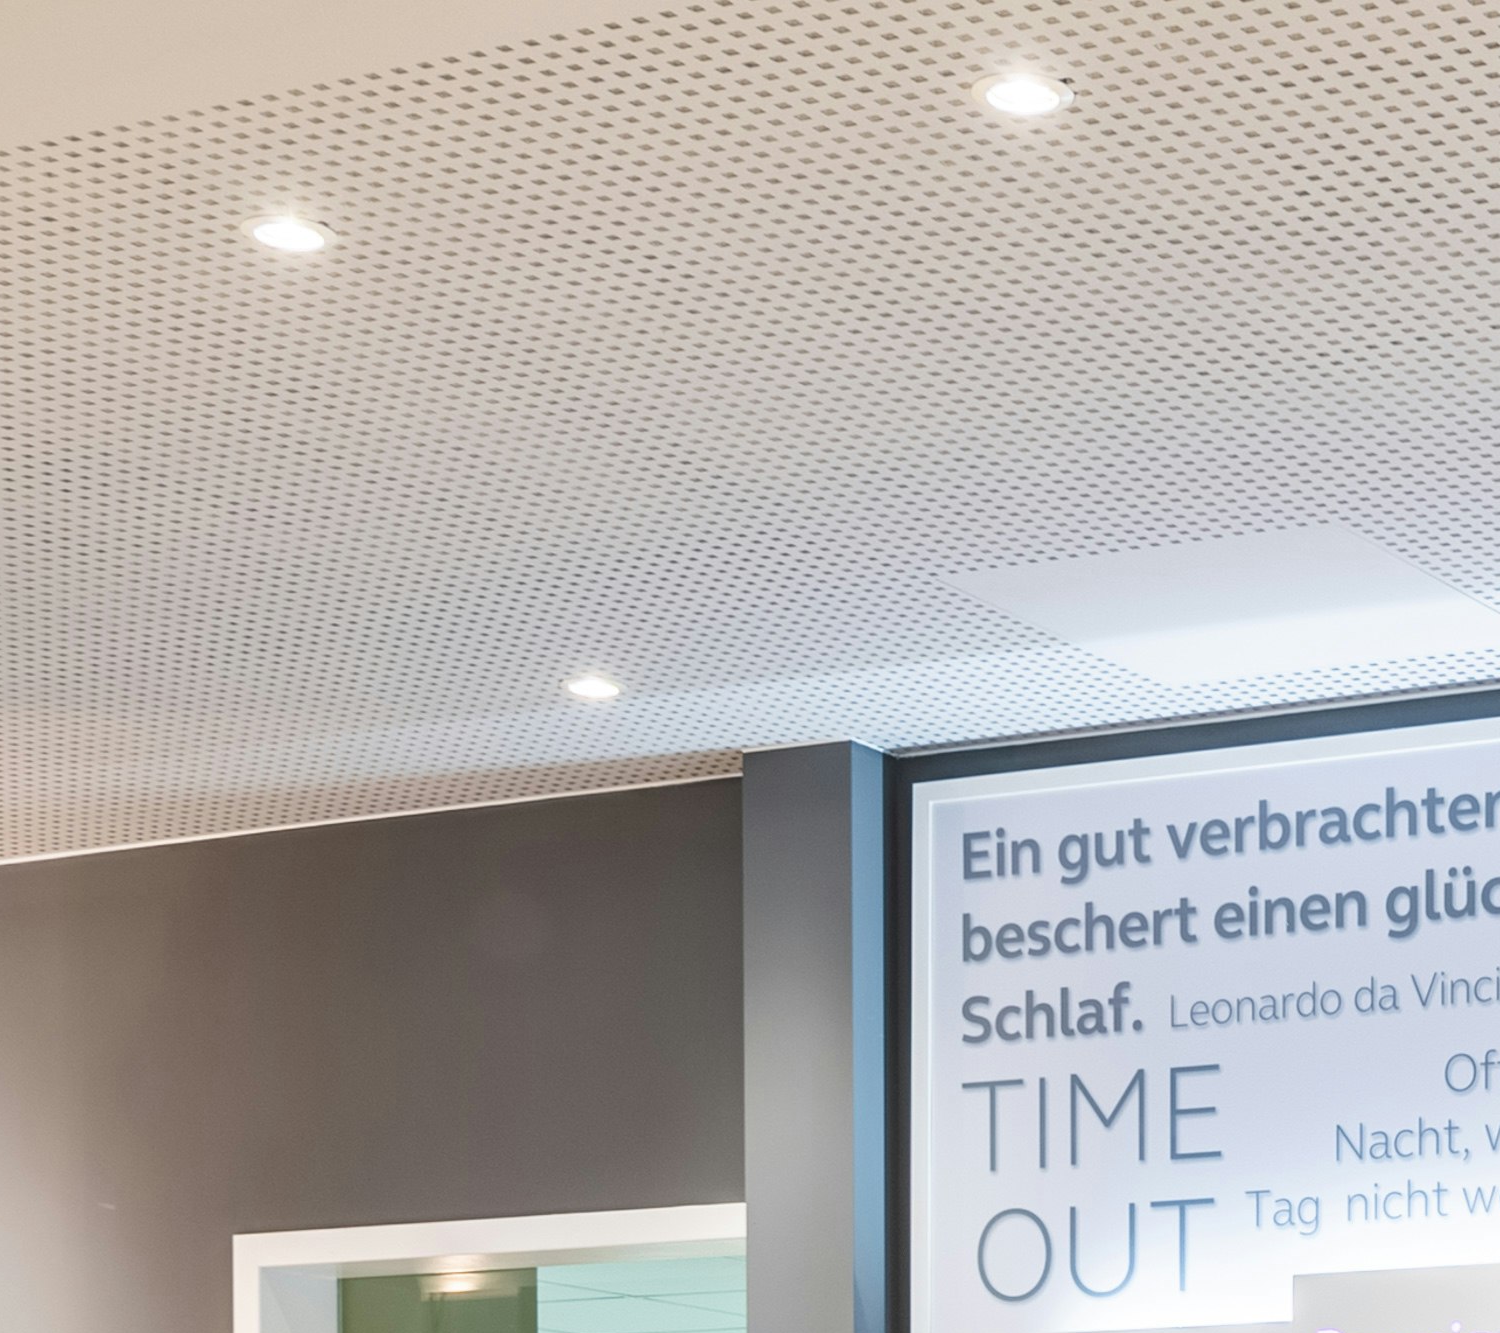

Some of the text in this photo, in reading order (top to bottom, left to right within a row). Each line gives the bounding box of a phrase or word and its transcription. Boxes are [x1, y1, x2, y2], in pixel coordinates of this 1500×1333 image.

[962, 829, 1041, 882] Ein
[1057, 819, 1151, 885] gut
[961, 900, 1198, 963] beschert
[1213, 886, 1368, 943] einen
[961, 983, 1145, 1044] Schlaf.
[1169, 982, 1344, 1030] Leonardo
[1353, 975, 1401, 1018] da
[961, 1063, 1224, 1174] TIME
[1335, 1115, 1470, 1166] Nacht,
[1245, 1188, 1320, 1236] Tag
[1346, 1178, 1451, 1224] nicht
[976, 1196, 1218, 1302] OUT
